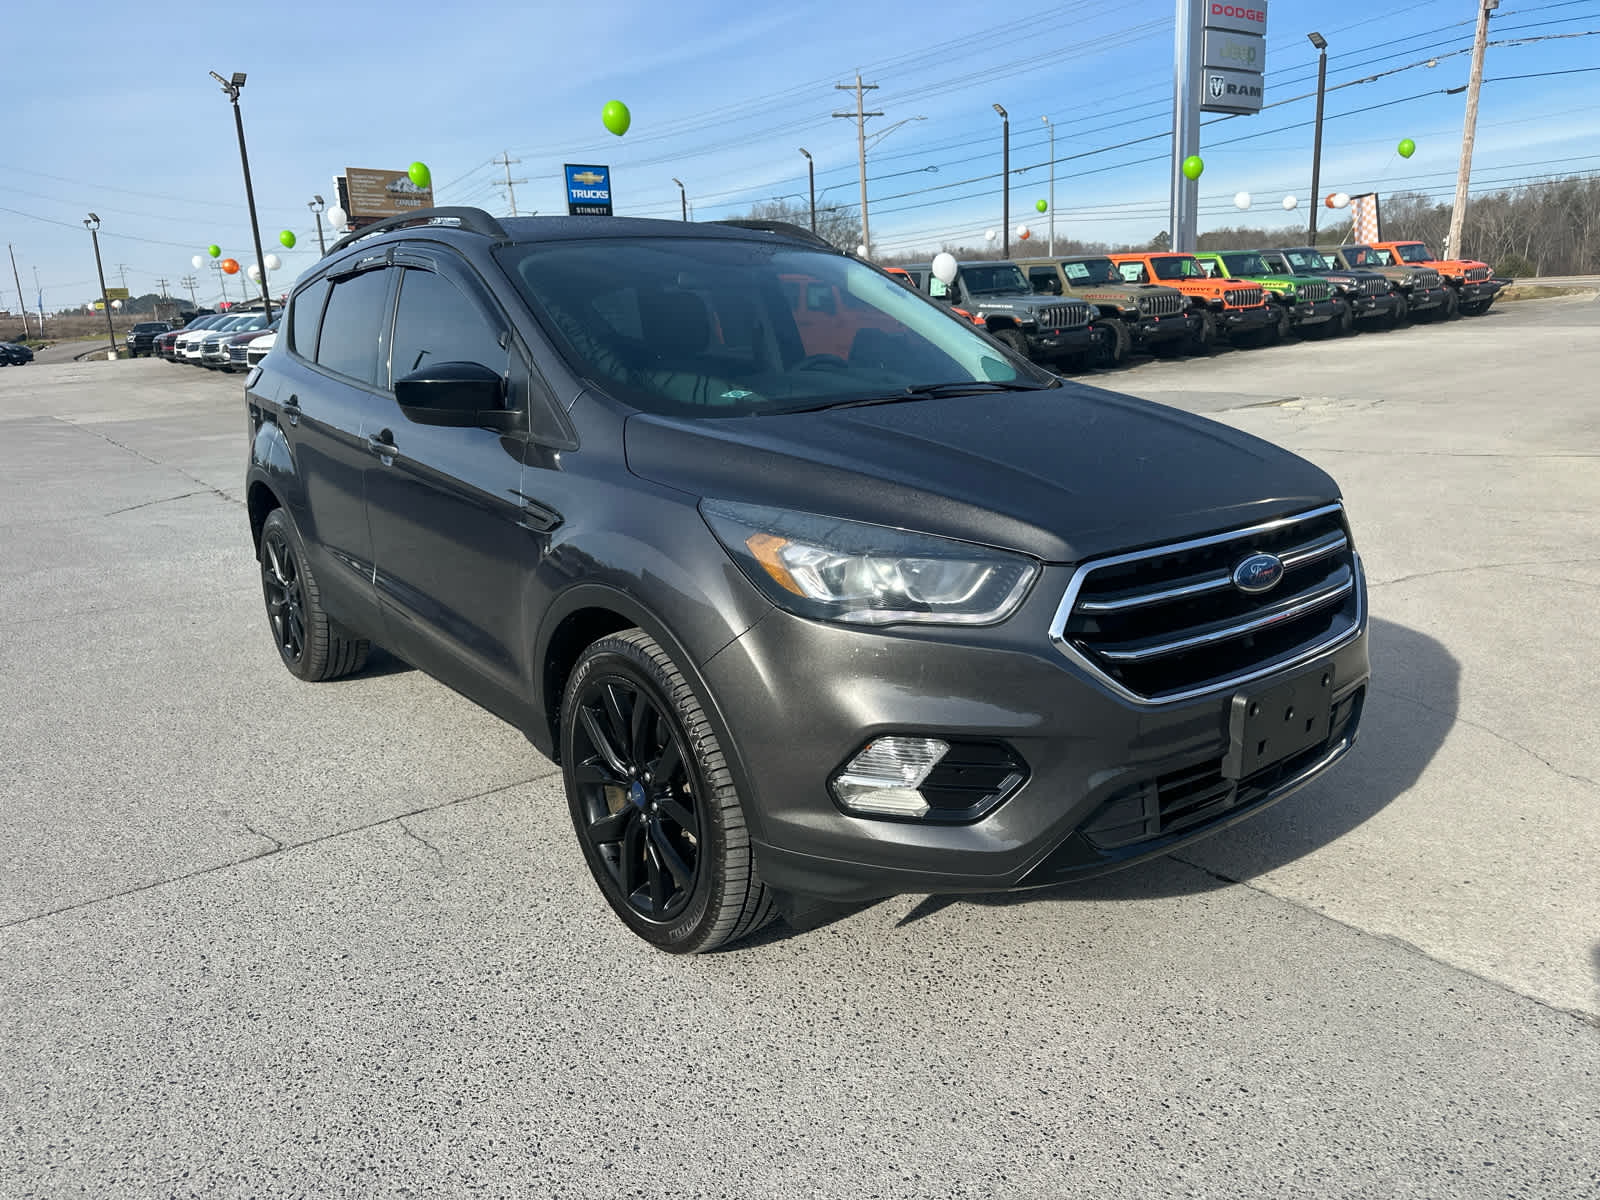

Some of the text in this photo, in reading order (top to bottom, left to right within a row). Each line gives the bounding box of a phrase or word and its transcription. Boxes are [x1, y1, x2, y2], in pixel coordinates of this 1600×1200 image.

[1211, 4, 1264, 22] DODGE
[1221, 38, 1256, 64] Jeep
[1226, 83, 1261, 97] RAM
[571, 189, 609, 199] TRUCKS
[1249, 562, 1274, 577] Ford
